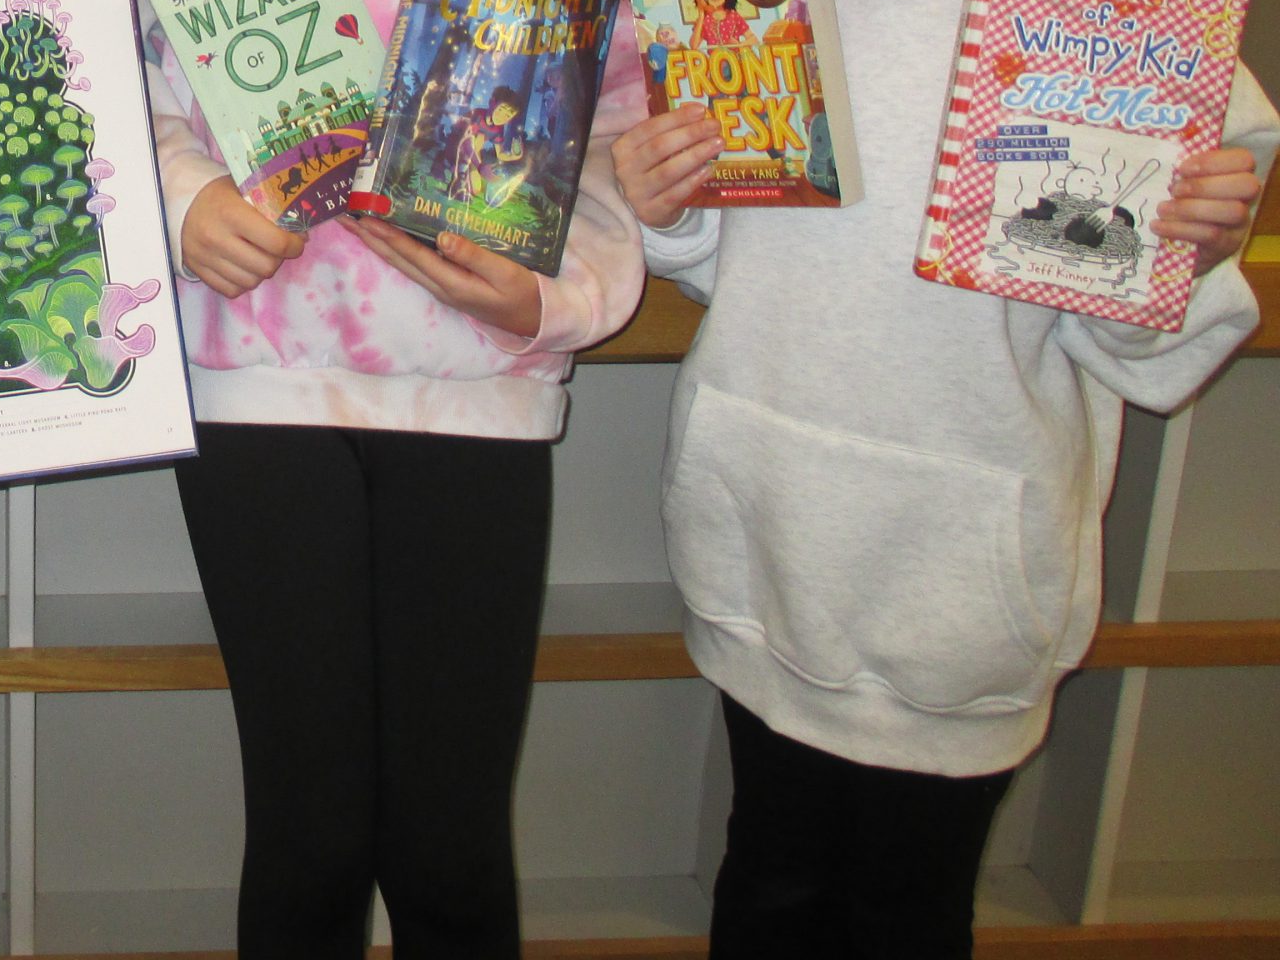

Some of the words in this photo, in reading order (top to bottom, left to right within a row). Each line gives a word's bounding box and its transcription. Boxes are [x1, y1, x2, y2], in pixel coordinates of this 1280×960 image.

[474, 15, 607, 56] CHILDREN
[1084, 3, 1112, 26] of
[1120, 19, 1135, 31] a
[225, 0, 343, 92] OZ
[247, 51, 266, 68] OF
[384, 15, 409, 91] MIDNIGHT
[1014, 15, 1132, 75] Wimpy
[1139, 32, 1202, 80] Kid
[664, 42, 801, 98] FRONT
[1002, 73, 1091, 112] Hot
[1084, 86, 1189, 127] Mess
[712, 96, 807, 152] ESK
[977, 139, 1004, 148] 290
[1010, 138, 1068, 148] MILLION
[1003, 126, 1041, 136] OVER
[715, 168, 746, 180] KELLY
[752, 168, 779, 179] YANG
[978, 151, 1022, 161] BOOKS
[1030, 151, 1067, 161] SOLD
[415, 196, 441, 218] DAN
[446, 207, 533, 248] GEMEINHART
[1027, 262, 1052, 277] Jeff
[1056, 266, 1096, 290] Kinney
